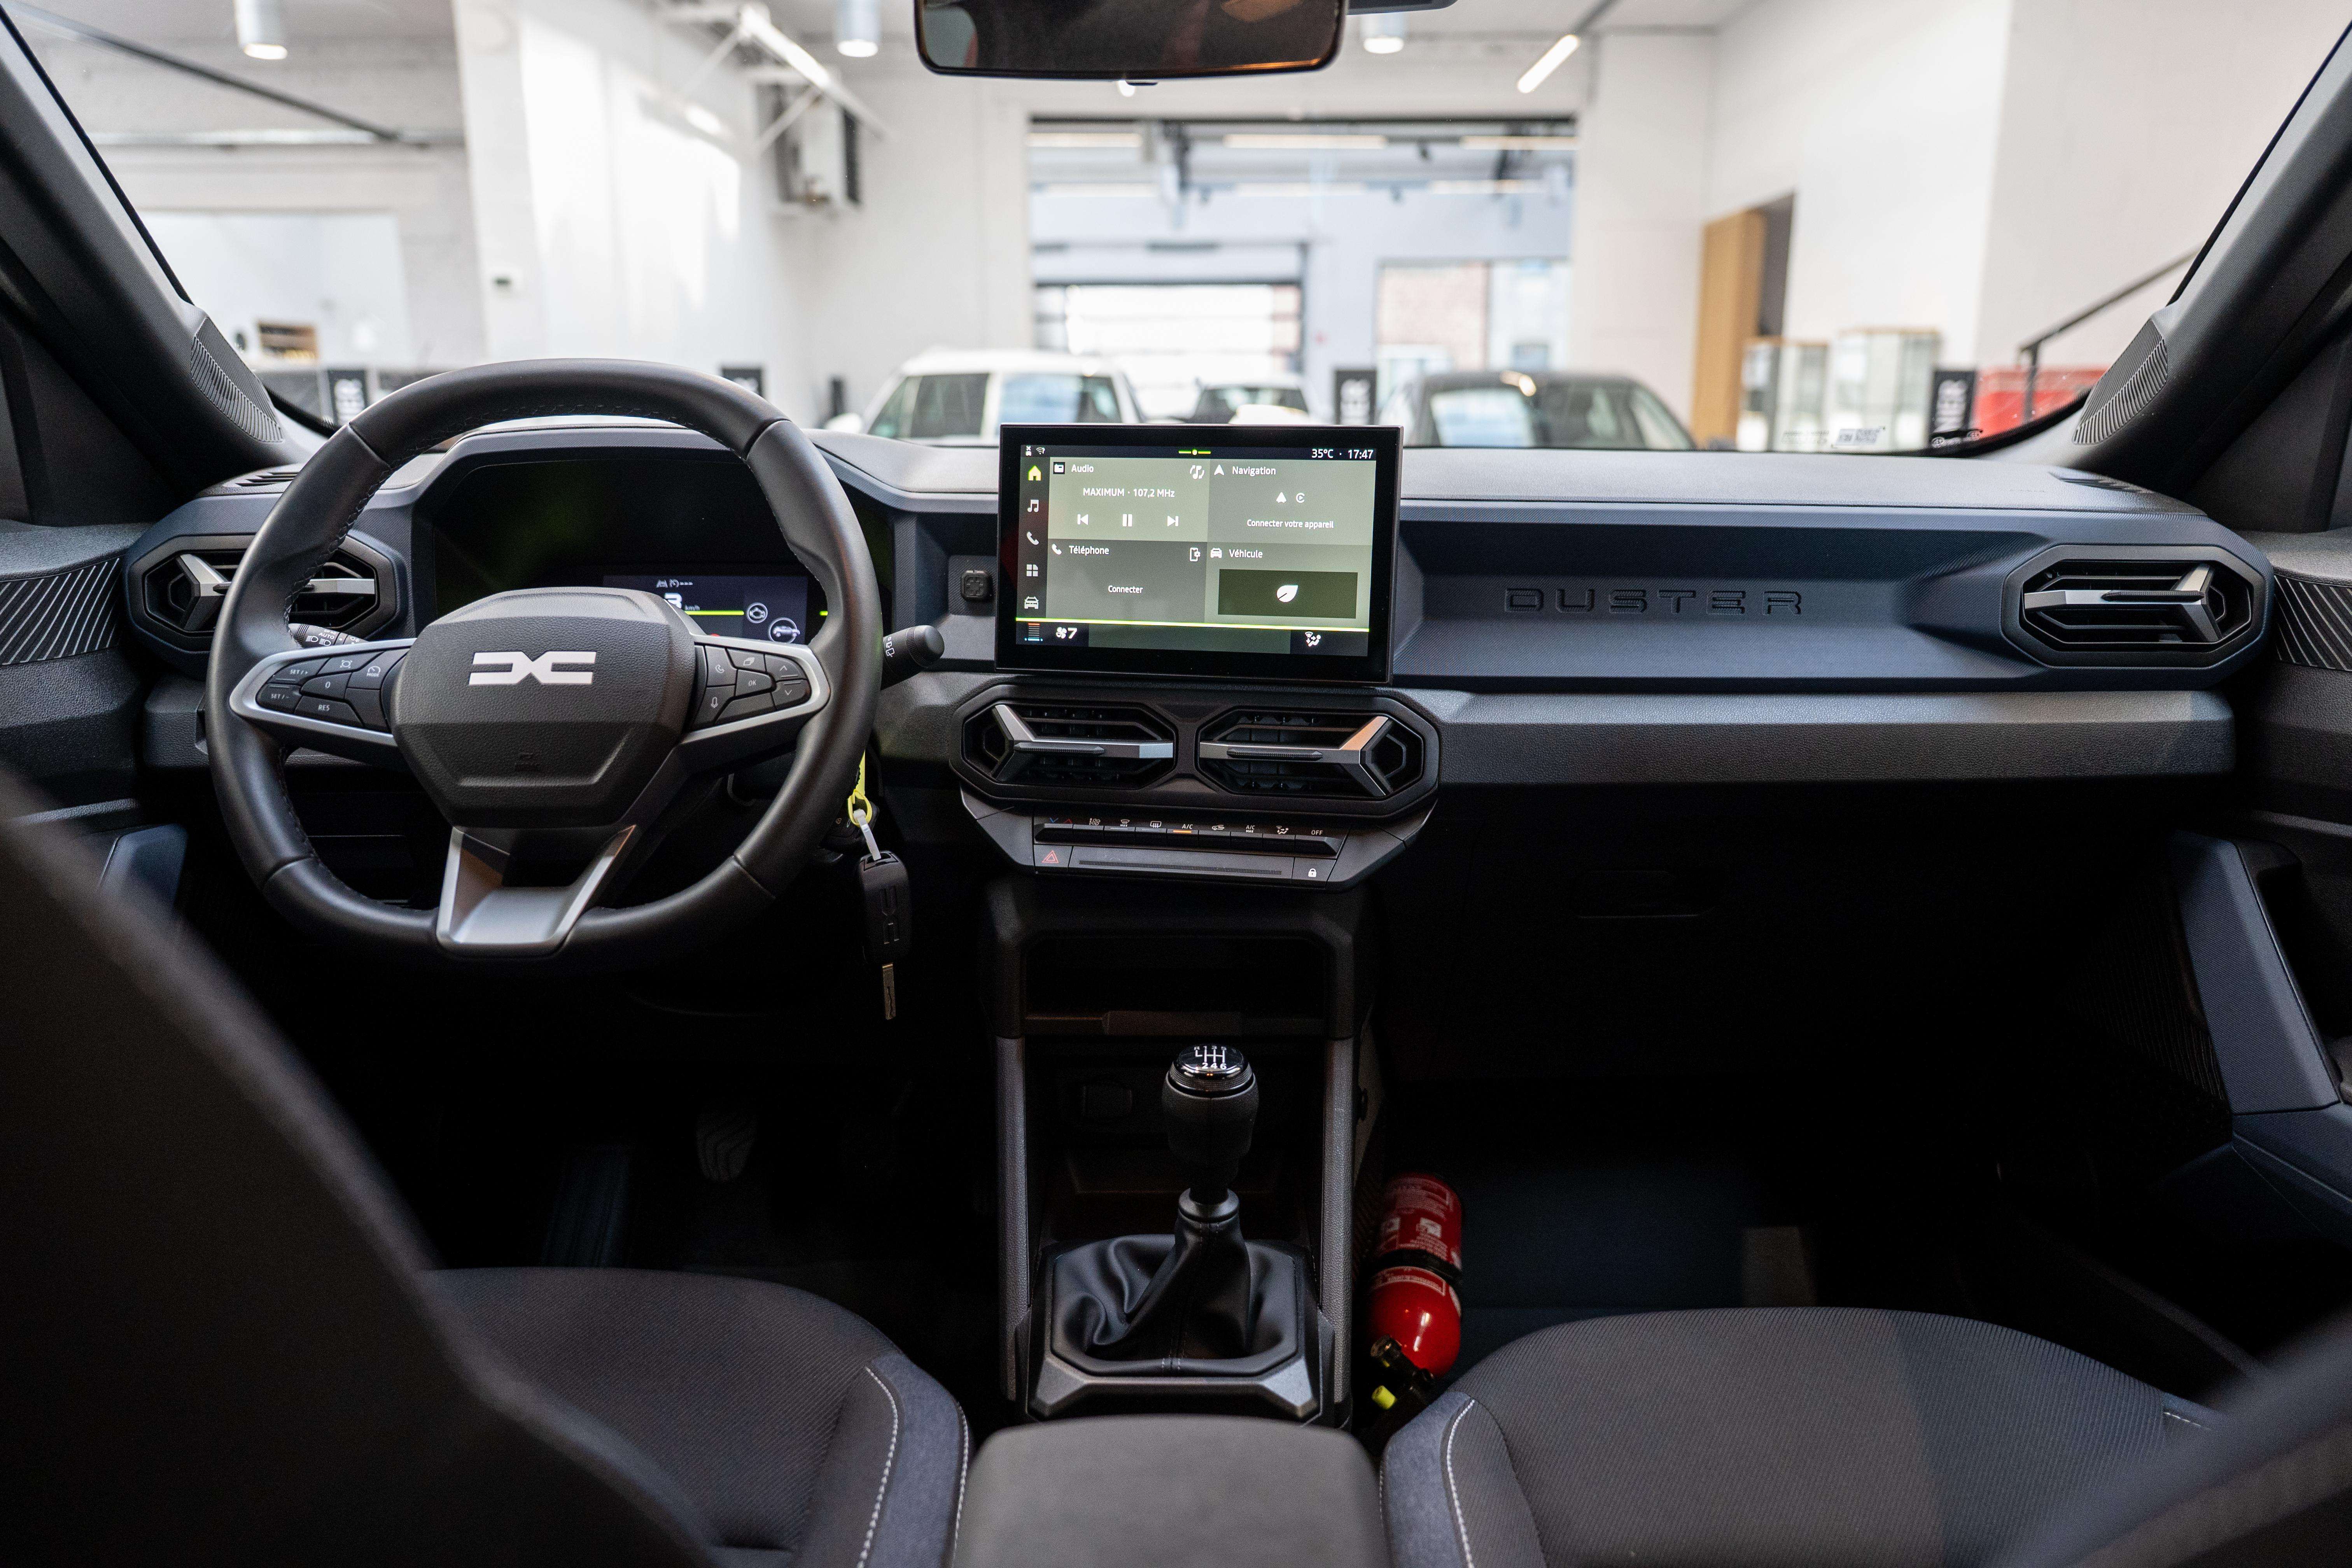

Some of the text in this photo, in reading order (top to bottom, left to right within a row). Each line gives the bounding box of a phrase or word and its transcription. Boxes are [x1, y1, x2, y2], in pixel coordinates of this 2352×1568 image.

[1311, 449, 1374, 459] 35°C 17:47
[1071, 464, 1094, 473] Audio
[1232, 466, 1276, 477] Navigation
[1083, 488, 1175, 498] MAXIMUM 107,2 MHz
[1247, 519, 1283, 527] Connecter
[1304, 521, 1334, 530] appareil
[1069, 545, 1110, 556] Téléphone
[1229, 549, 1263, 558] Véhicule
[1108, 585, 1143, 593] Connecter
[1505, 588, 1802, 615] DUSTER
[1068, 627, 1078, 639] 7
